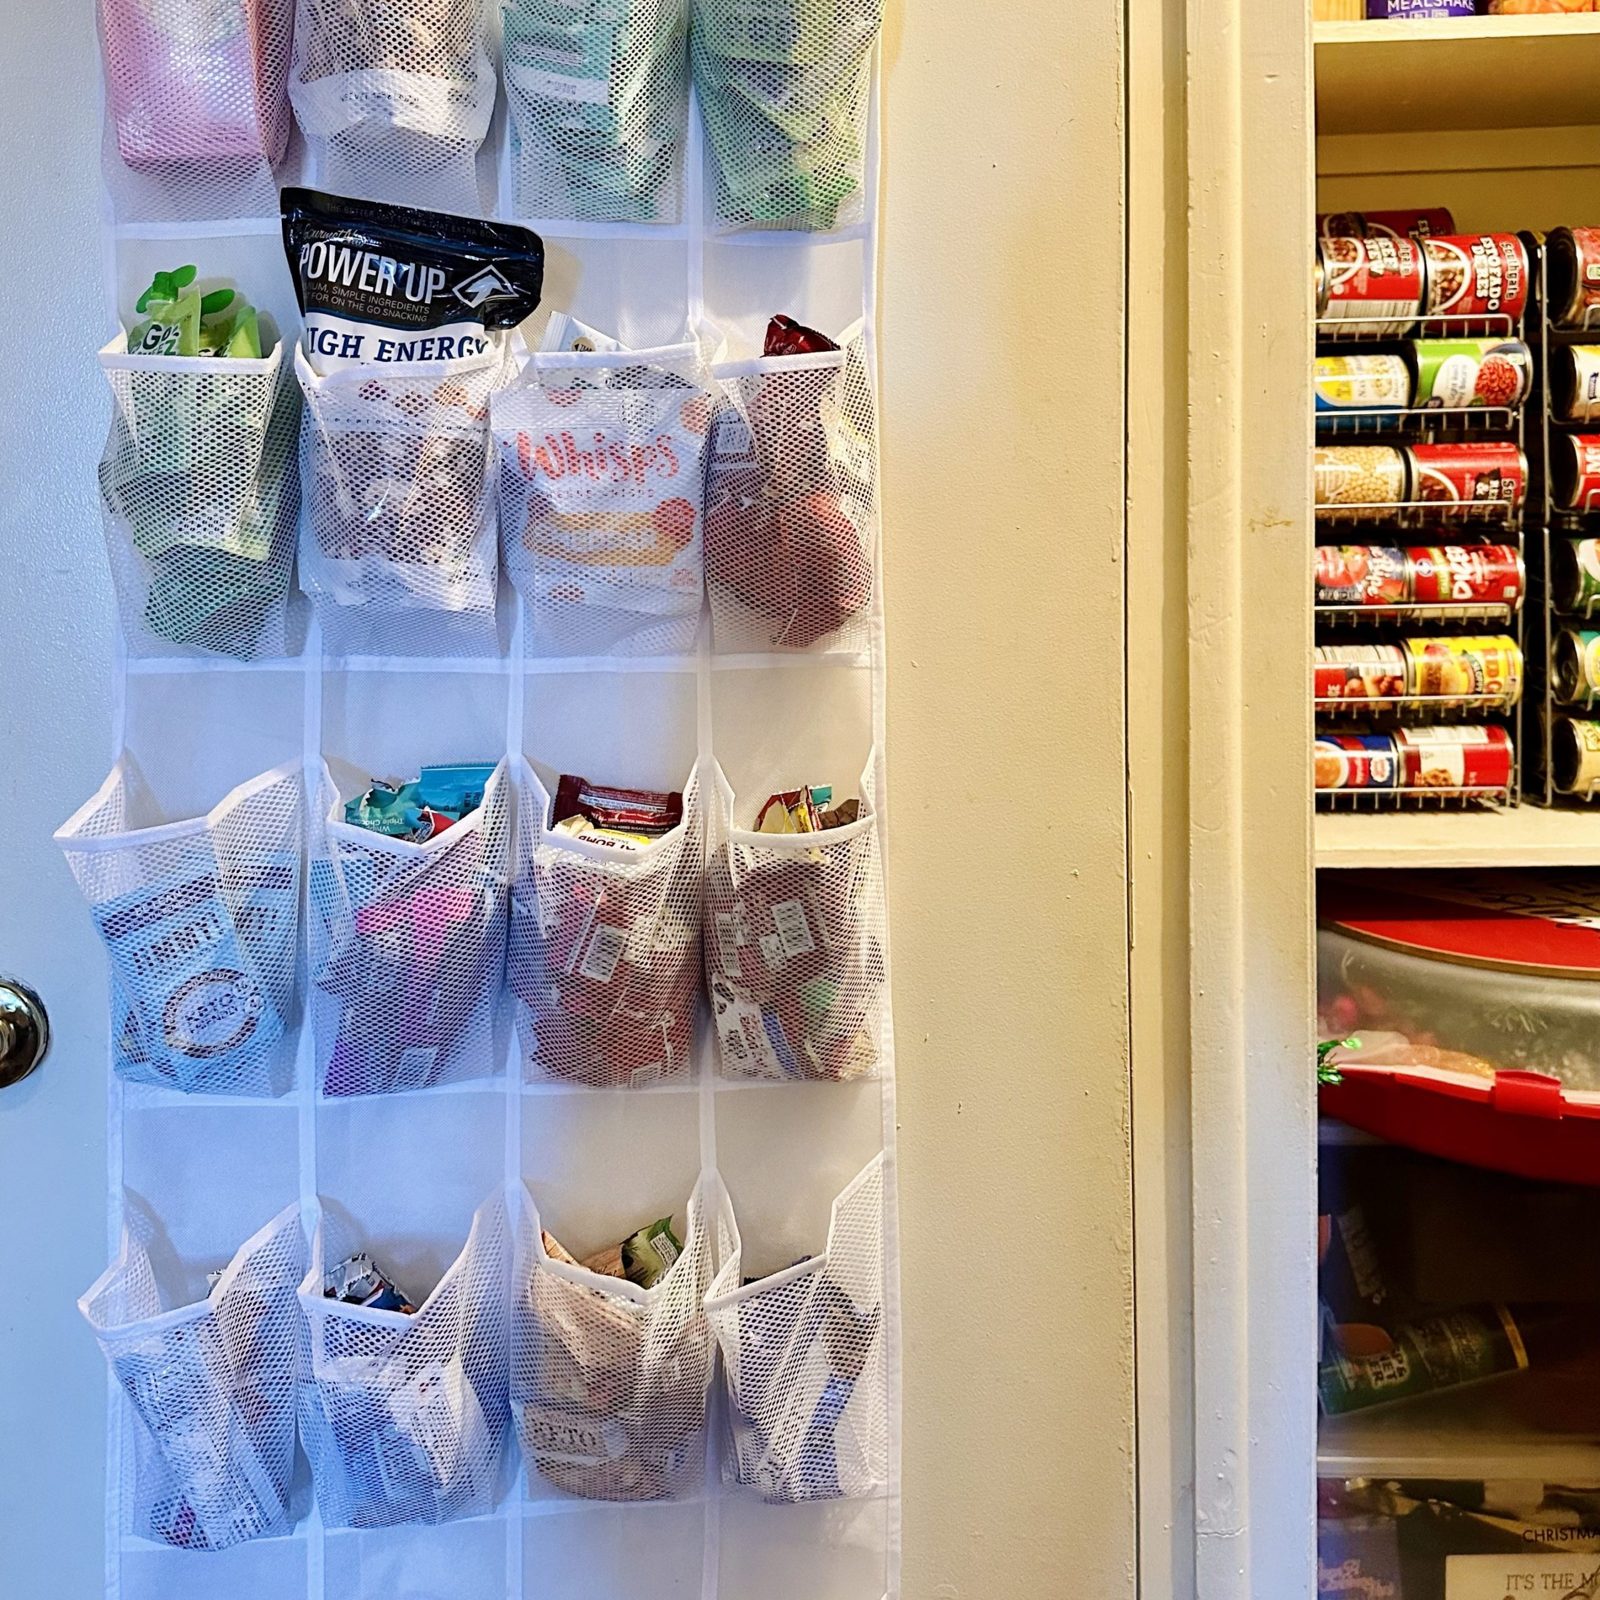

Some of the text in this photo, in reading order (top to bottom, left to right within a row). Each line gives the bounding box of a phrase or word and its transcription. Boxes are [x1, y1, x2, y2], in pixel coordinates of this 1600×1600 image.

[299, 241, 446, 305] POWER UP
[311, 292, 428, 322] FOR ON THE GO SNACKING
[331, 286, 366, 301] SIMPLE
[368, 295, 430, 315] INGREDIENTS
[307, 327, 489, 361] IGH ENERGY
[516, 430, 680, 486] Whisps
[1506, 1573, 1535, 1591] IT'S
[1540, 1573, 1575, 1590] THE
